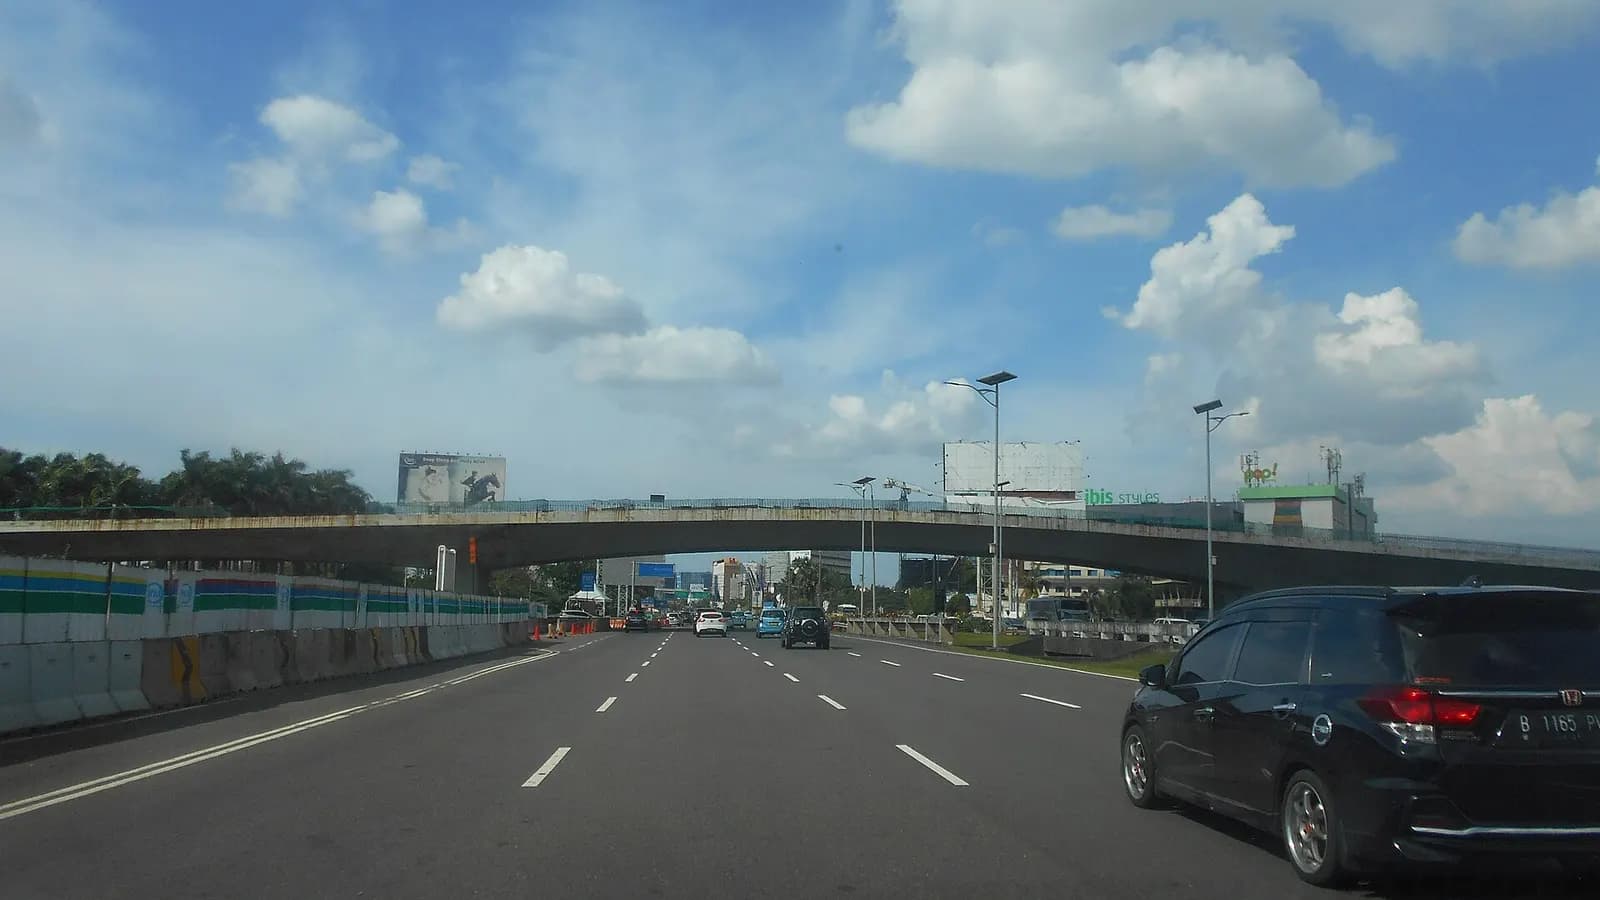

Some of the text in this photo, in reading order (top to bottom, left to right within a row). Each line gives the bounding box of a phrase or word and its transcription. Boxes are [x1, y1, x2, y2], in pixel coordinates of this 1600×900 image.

[1085, 488, 1113, 504] ibis
[1520, 715, 1530, 732] B
[1543, 714, 1576, 732] 1165
